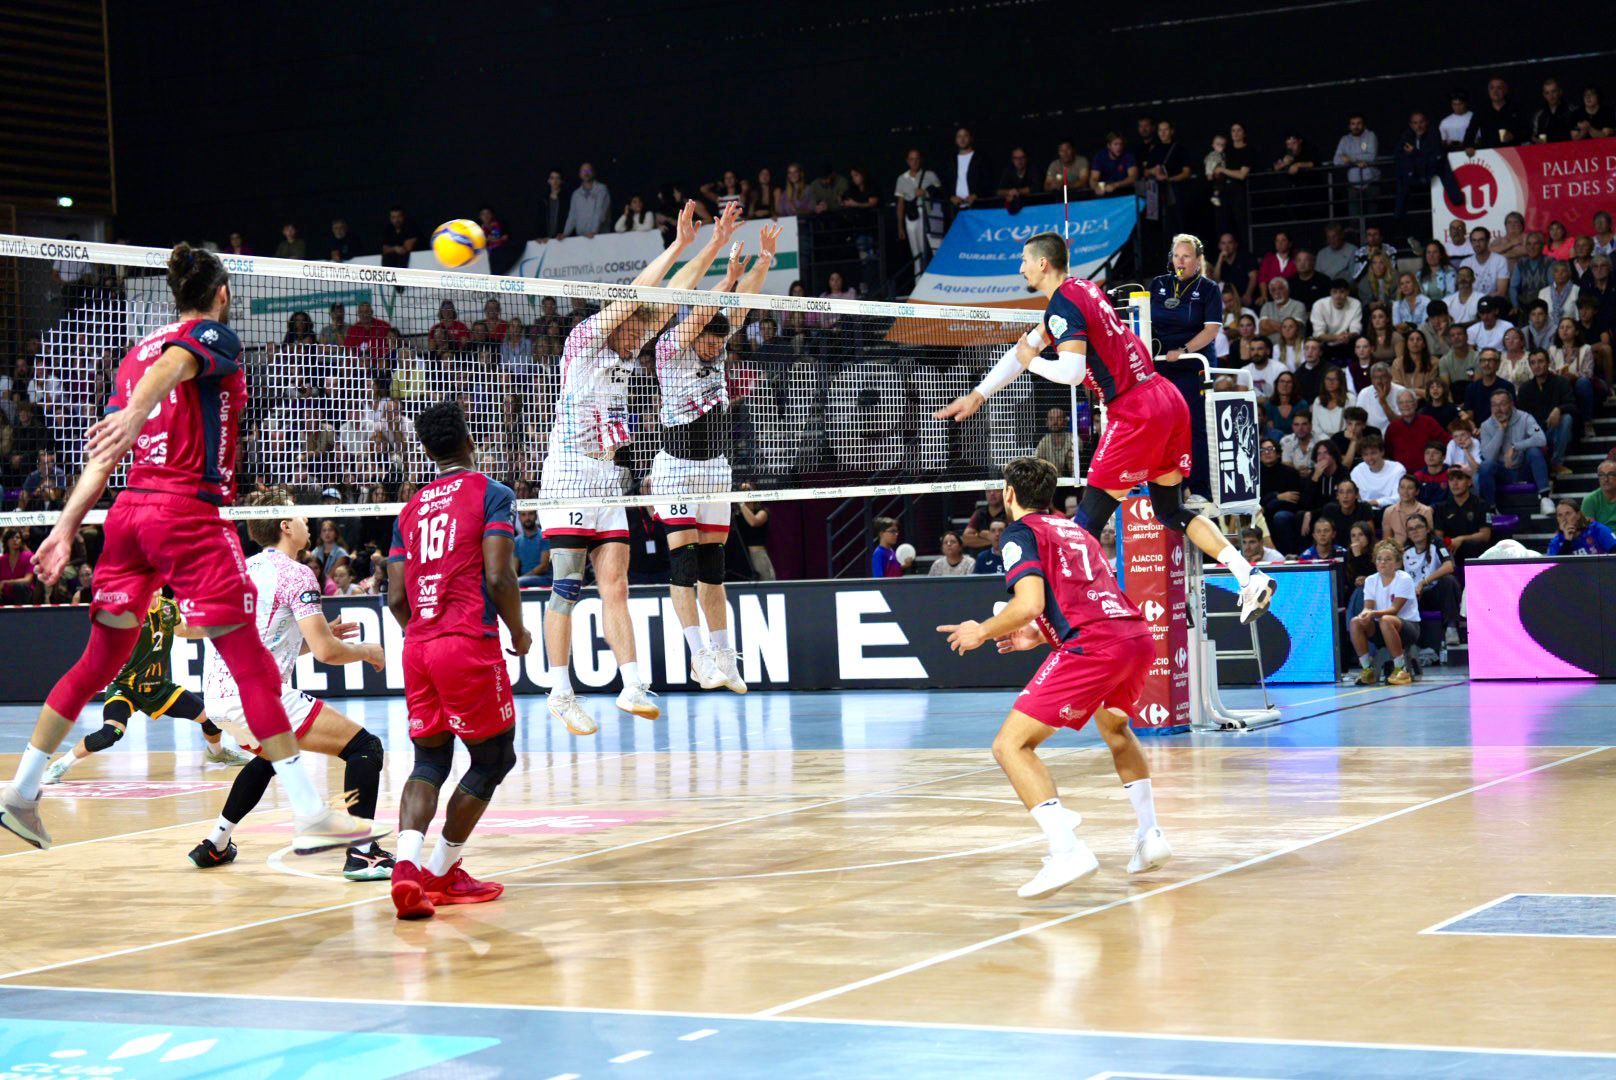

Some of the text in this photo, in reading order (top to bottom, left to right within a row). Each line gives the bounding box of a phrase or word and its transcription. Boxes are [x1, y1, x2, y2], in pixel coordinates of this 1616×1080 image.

[1543, 157, 1599, 176] PALAIS
[1543, 184, 1562, 199] ET
[1569, 180, 1600, 197] DES
[40, 243, 89, 260] CORSICA
[604, 260, 648, 273] CORSICA
[360, 269, 397, 283] CORSICA
[499, 280, 525, 292] CORSE
[607, 287, 638, 299] CORSICA
[934, 282, 1020, 297] Aquaculture
[719, 295, 740, 306] CORSE
[807, 301, 832, 312] CORSICA
[970, 309, 991, 320] CORSICA
[671, 504, 688, 516] 88
[569, 512, 583, 526] 12
[1128, 523, 1164, 532] Carrefour
[418, 513, 449, 564] 16
[1133, 532, 1160, 540] market
[1069, 542, 1094, 581] 7
[1132, 555, 1163, 563] AJACCIO
[1130, 564, 1165, 572] Albert 1er
[244, 592, 254, 614] 6
[152, 631, 163, 651] 2
[836, 591, 929, 680] E
[499, 702, 513, 722] 16
